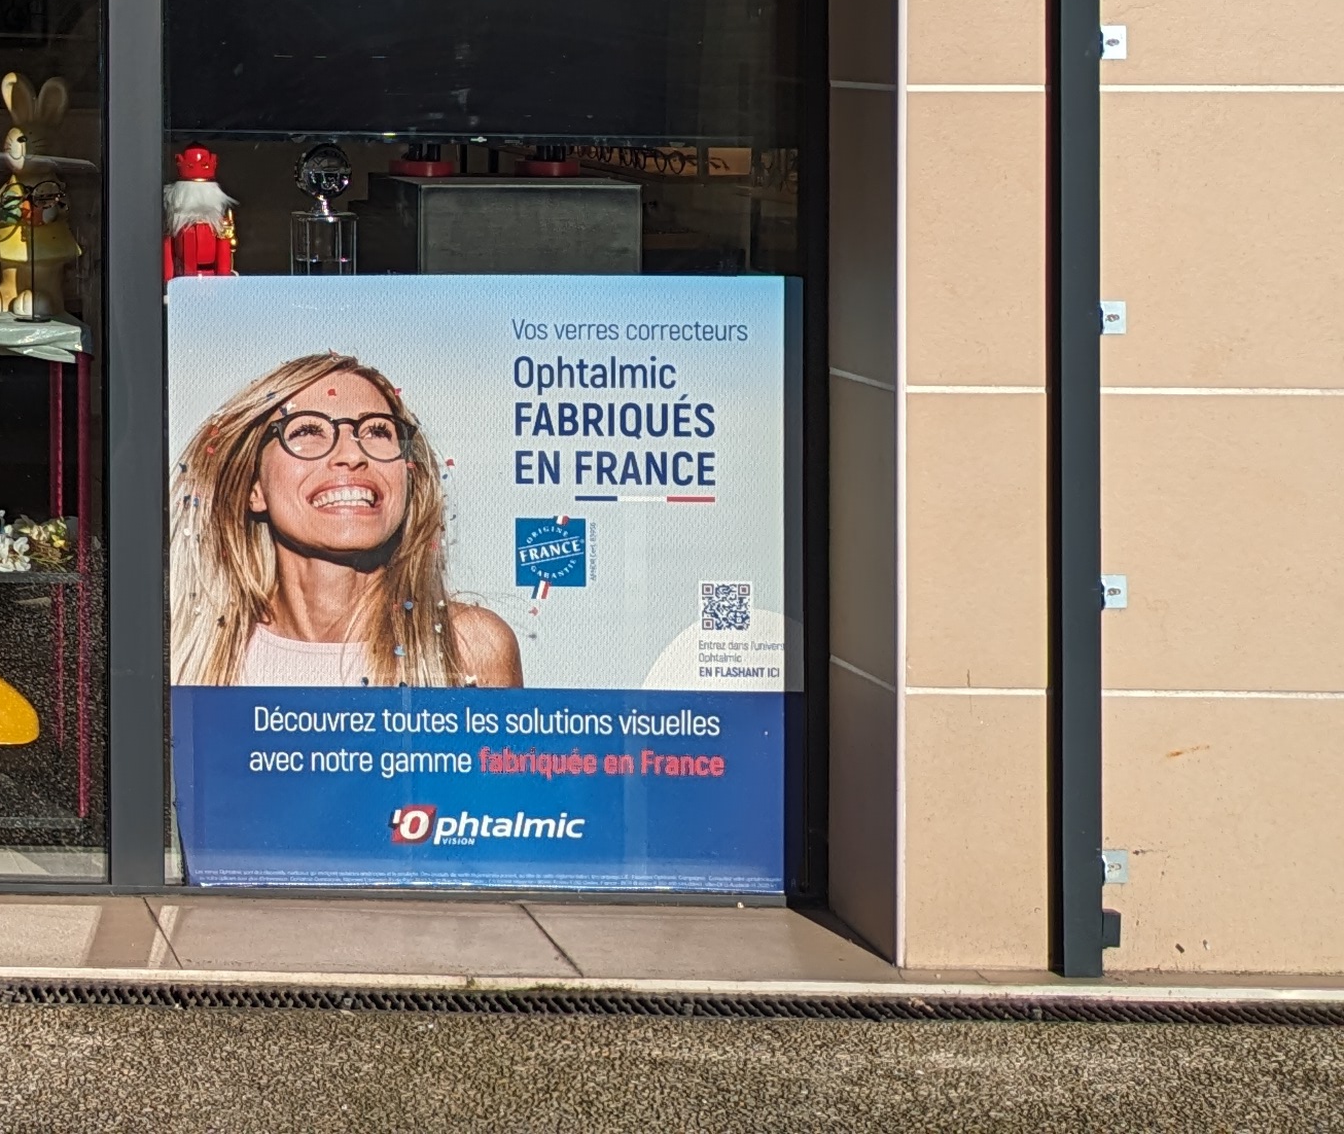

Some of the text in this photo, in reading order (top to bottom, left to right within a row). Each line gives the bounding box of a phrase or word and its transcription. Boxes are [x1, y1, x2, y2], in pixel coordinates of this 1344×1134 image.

[512, 319, 749, 343] Vos verres correcteurs
[513, 355, 677, 398] Ophtalmic
[514, 394, 716, 439] FABRIQUÉS
[515, 451, 716, 487] EN FRANCE
[525, 525, 569, 544] ORIGINE
[519, 539, 582, 563] FRANCE
[698, 640, 726, 651] Entrez
[727, 640, 749, 651] dans
[698, 652, 742, 664] Ophtalmic
[699, 667, 780, 679] EN FLASHANT ICI
[253, 706, 720, 736] Découvrez toutes les solutions visuelles
[249, 748, 726, 779] avec notre gamme fabriquée en France
[442, 837, 476, 845] VISION
